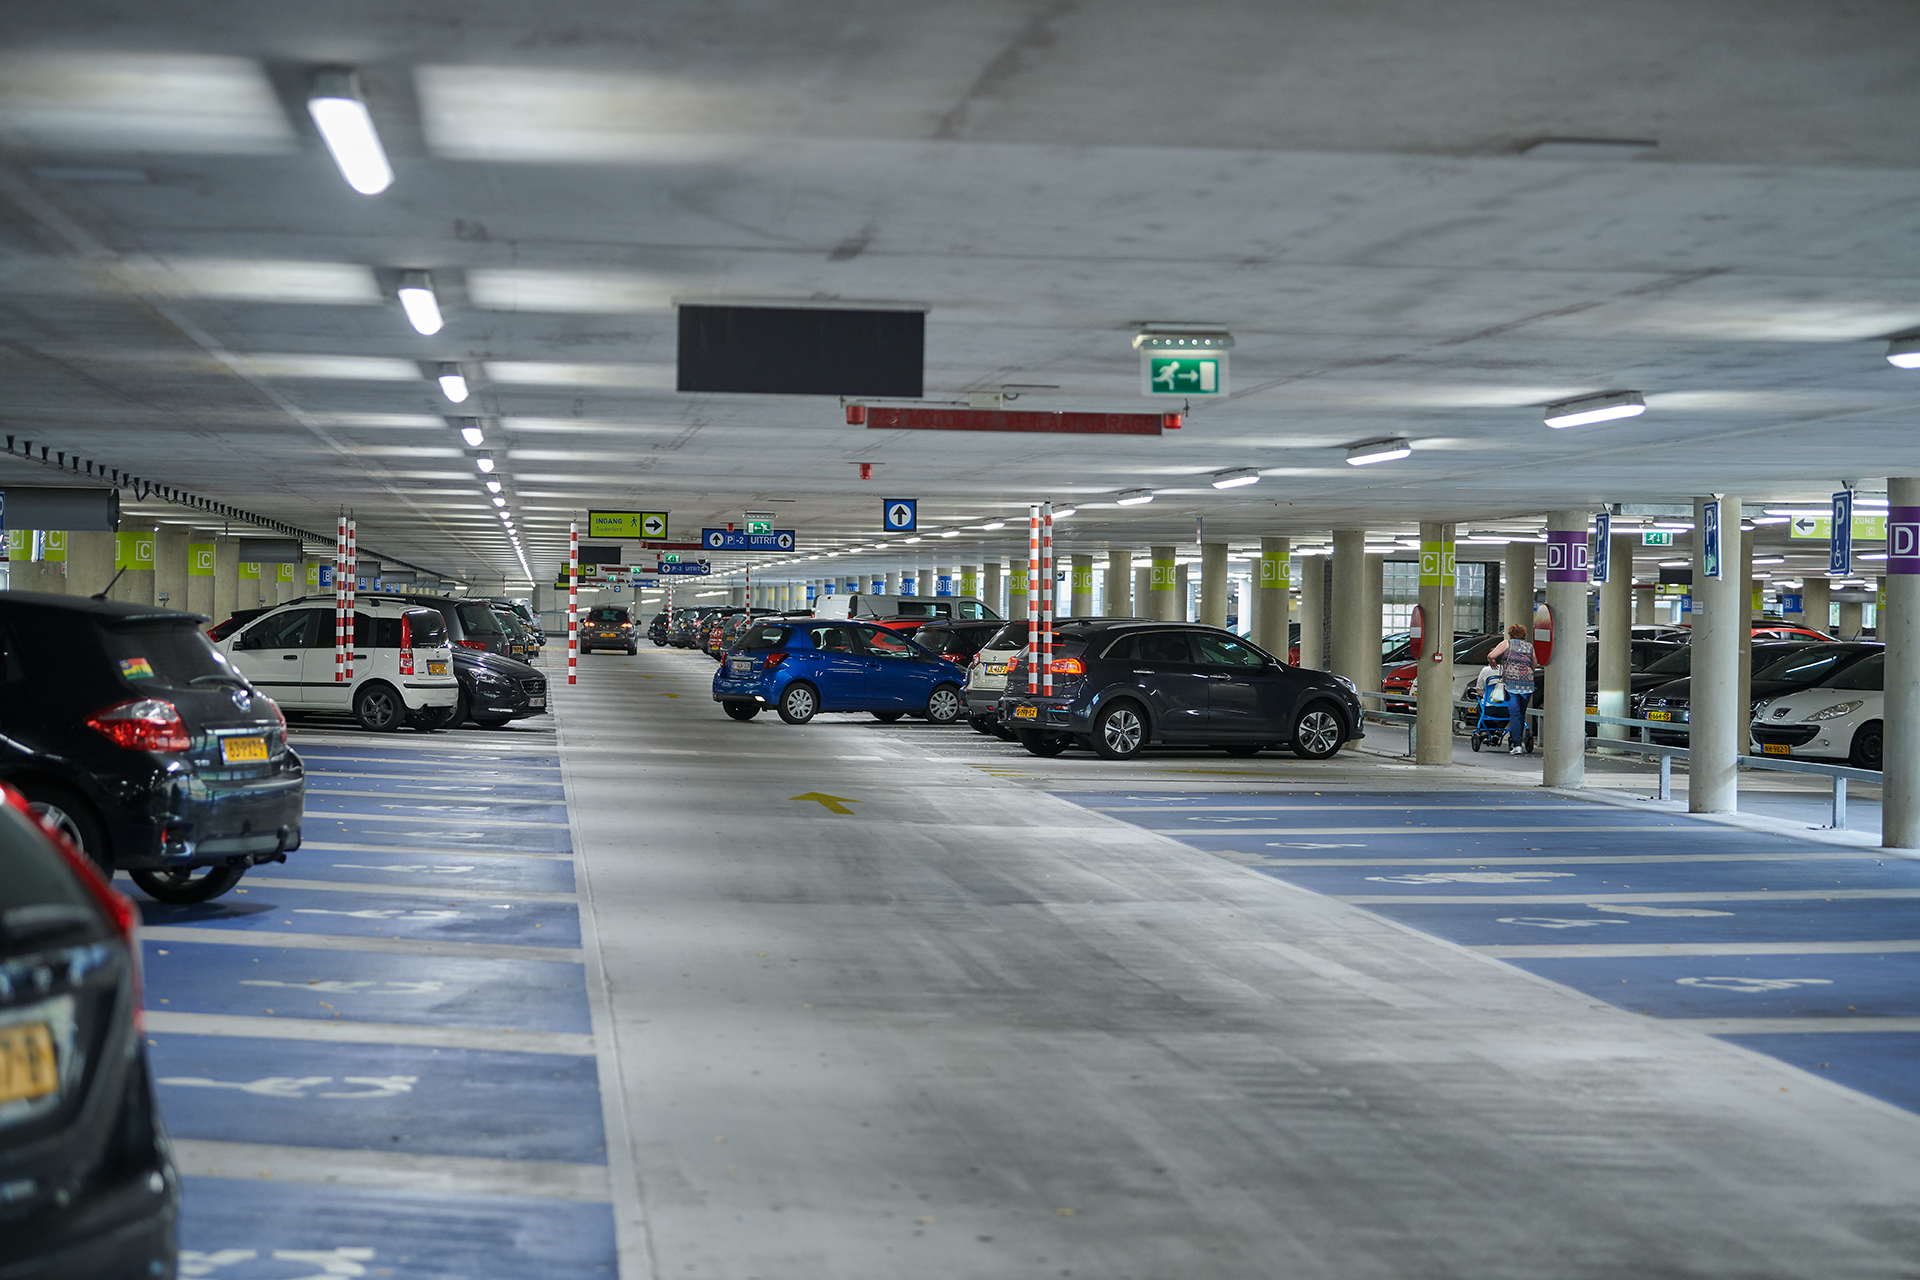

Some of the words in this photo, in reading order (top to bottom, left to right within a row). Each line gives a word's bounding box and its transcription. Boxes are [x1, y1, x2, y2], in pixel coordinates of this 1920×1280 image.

[1834, 500, 1845, 539] P
[1706, 510, 1713, 545] P
[11, 530, 20, 546] C
[49, 530, 60, 547] C
[1596, 521, 1604, 552] P
[1895, 527, 1913, 554] D
[140, 543, 150, 558] C
[1549, 546, 1561, 567] D
[1577, 546, 1588, 567] D
[201, 553, 210, 566] C
[1422, 554, 1434, 573] C
[285, 565, 291, 575] C
[311, 569, 317, 579] C
[325, 572, 331, 580] B
[1153, 569, 1160, 581] C
[1262, 563, 1271, 577] C
[1010, 577, 1016, 588] C
[1684, 600, 1689, 608] B
[1785, 600, 1790, 608] B
